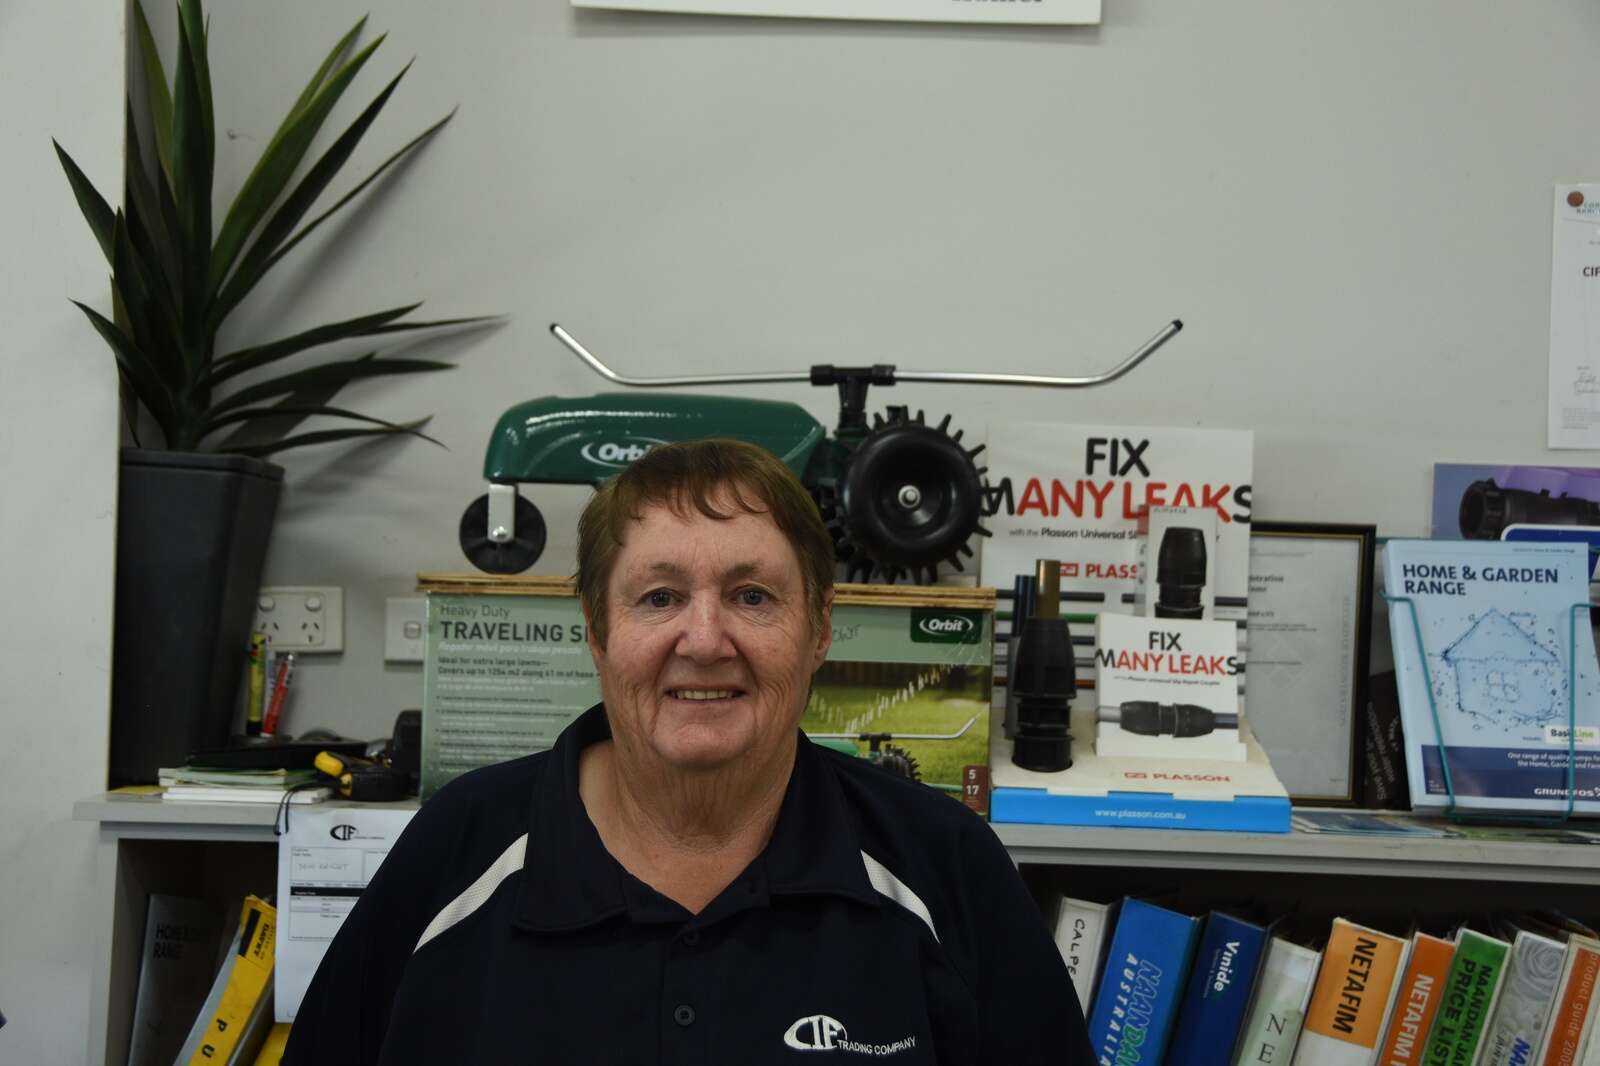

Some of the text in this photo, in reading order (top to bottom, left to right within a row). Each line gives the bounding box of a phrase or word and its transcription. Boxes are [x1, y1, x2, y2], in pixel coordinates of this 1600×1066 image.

[598, 442, 652, 461] Orb
[1086, 437, 1151, 477] FIX
[983, 477, 1253, 523] MANY LEAKS
[1041, 527, 1079, 538] Plasson
[1080, 529, 1126, 540] Universal
[1086, 564, 1137, 578] PLASS
[1402, 564, 1558, 583] HOME & GARDEN
[1404, 580, 1467, 596] RANGE
[440, 604, 510, 619] Heavy Duty
[440, 621, 563, 642] TRAVELING
[928, 618, 965, 631] Orbit
[1149, 631, 1182, 651] FIX
[438, 666, 464, 674] Covers
[466, 668, 476, 676] up
[522, 669, 543, 678] along
[495, 658, 515, 667] large
[1095, 648, 1238, 676] MANY LEAKS
[968, 769, 977, 780] 5
[1152, 772, 1233, 783] PLASSON
[966, 784, 980, 796] 17
[1094, 808, 1187, 820] www.plasson.com.au
[1332, 937, 1379, 1034] NETAFIM
[1581, 953, 1600, 1000] product
[1099, 952, 1138, 1066] AUSTRALIA
[1115, 959, 1163, 1066] NAANDA
[1430, 957, 1477, 1066] PRICE LIST
[1460, 965, 1493, 1042] NAANDAN
[1394, 973, 1434, 1059] NETAFIM
[1567, 1002, 1585, 1036] guide
[783, 1014, 917, 1055] CIF TRADING COMPANY
